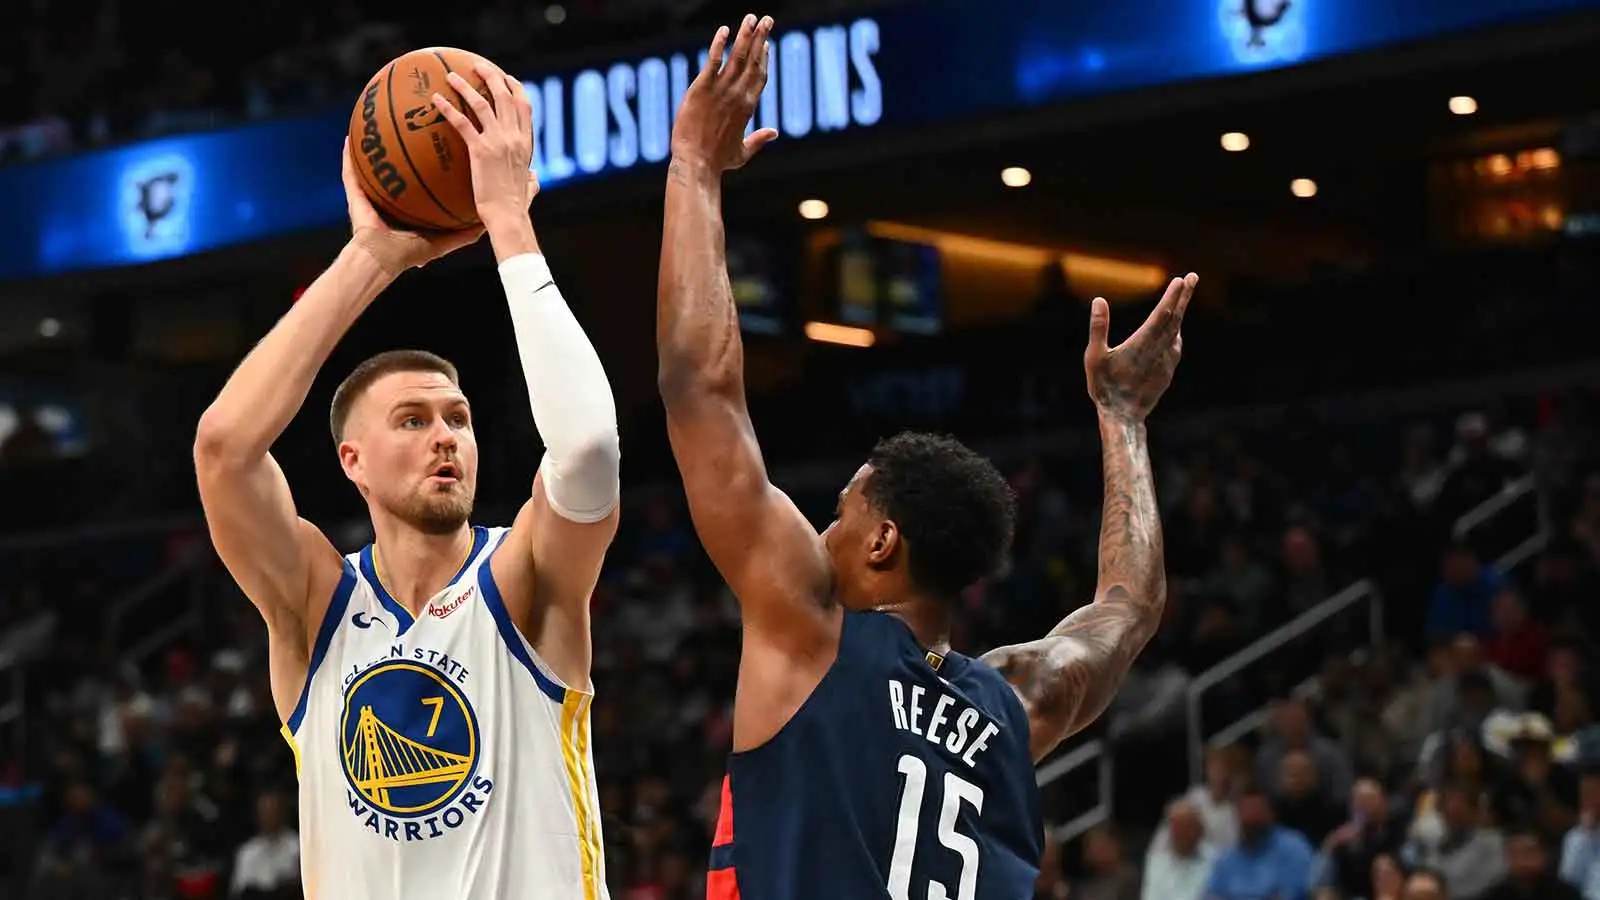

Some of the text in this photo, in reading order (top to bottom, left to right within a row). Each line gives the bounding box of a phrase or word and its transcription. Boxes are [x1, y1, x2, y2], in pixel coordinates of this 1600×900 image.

[428, 585, 475, 618] Rakuten
[341, 643, 469, 697] OLN STATE
[421, 696, 444, 737] 7
[888, 679, 1000, 768] REESE
[346, 775, 494, 842] WARRIORS
[886, 754, 984, 900] 15
